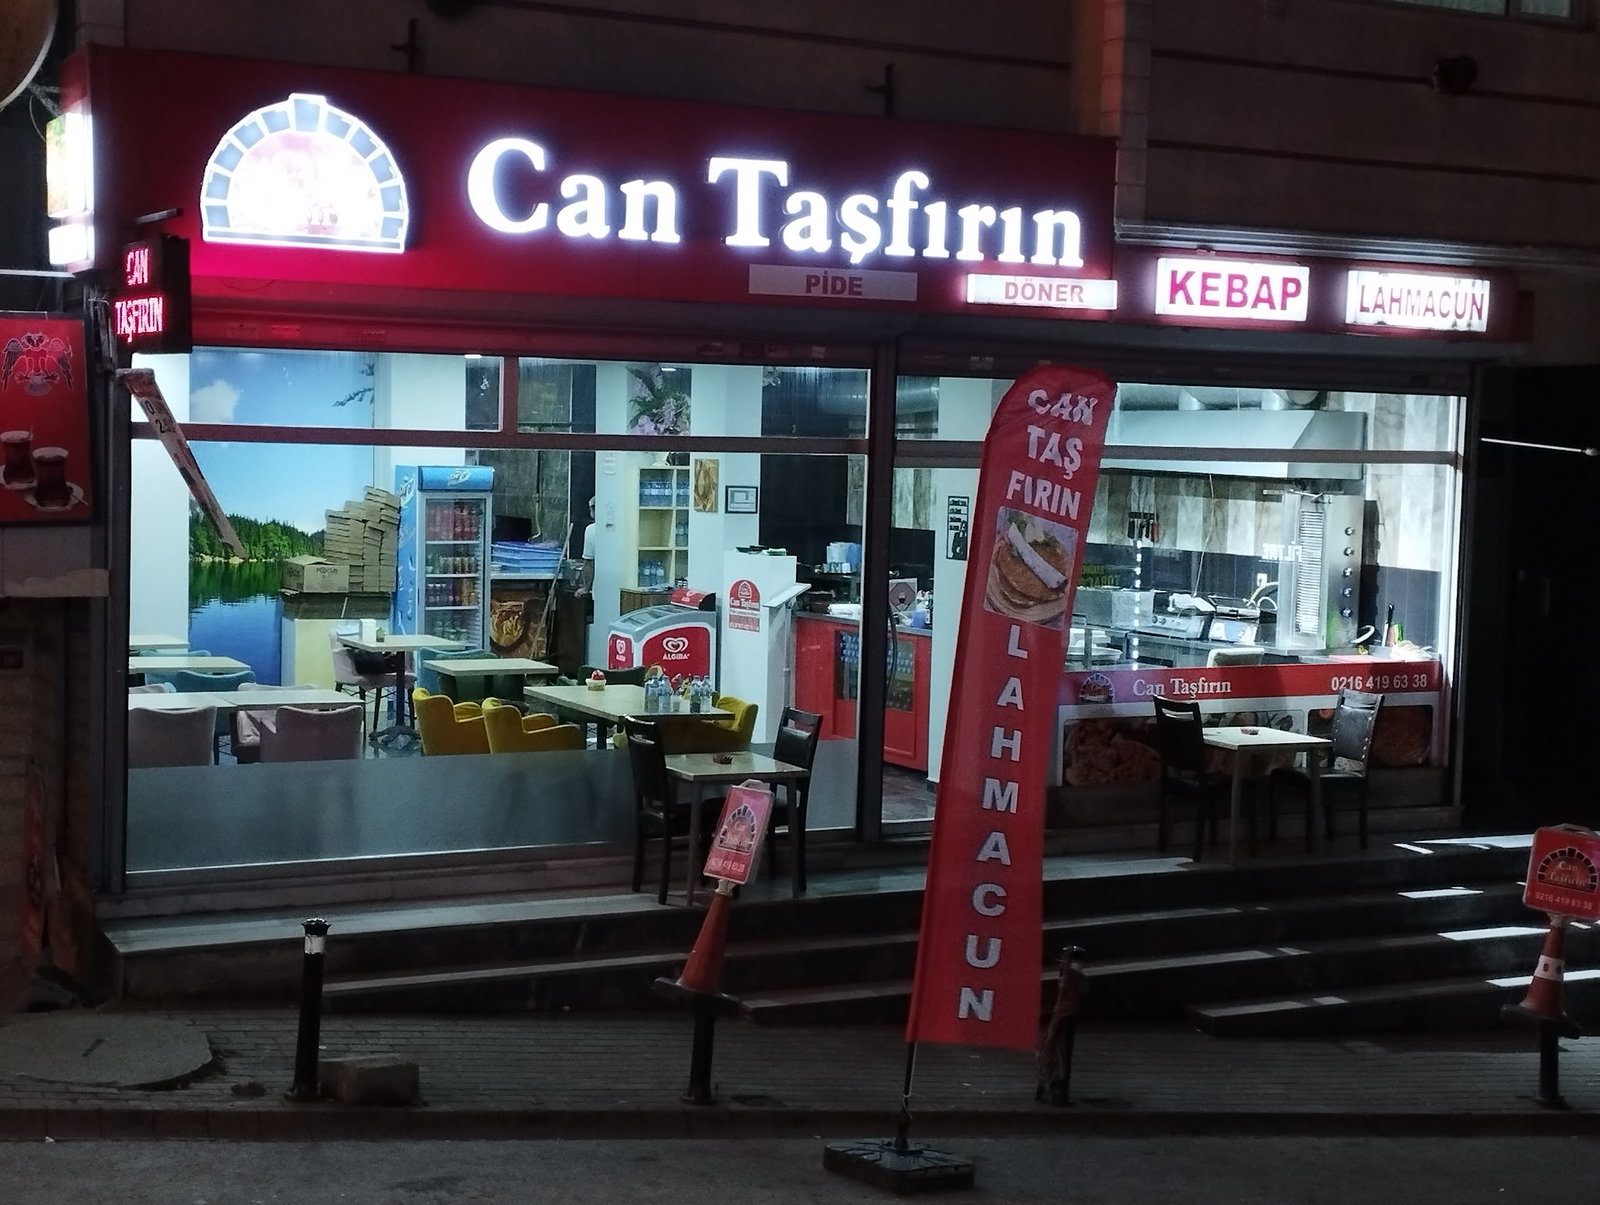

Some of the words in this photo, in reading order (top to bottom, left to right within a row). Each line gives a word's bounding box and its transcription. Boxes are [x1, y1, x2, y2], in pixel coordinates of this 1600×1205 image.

[466, 137, 682, 243] Can
[706, 155, 1085, 267] Taşfırın
[126, 248, 149, 286] CAN
[805, 270, 863, 296] PİDE
[1004, 277, 1085, 303] DÖNER
[1168, 269, 1302, 311] KEBAP
[1359, 284, 1484, 320] LAHMACUN
[1027, 389, 1098, 426] CAN
[1027, 425, 1083, 480] TAŞ
[1006, 470, 1081, 520] FIRIN
[1132, 678, 1166, 696] Can
[1170, 677, 1232, 698] Taşfırın
[1331, 675, 1363, 691] 0216
[1366, 674, 1390, 690] 419
[1393, 674, 1409, 689] 63
[1412, 673, 1428, 688] 38
[957, 624, 1029, 1022] LAHMACUN
